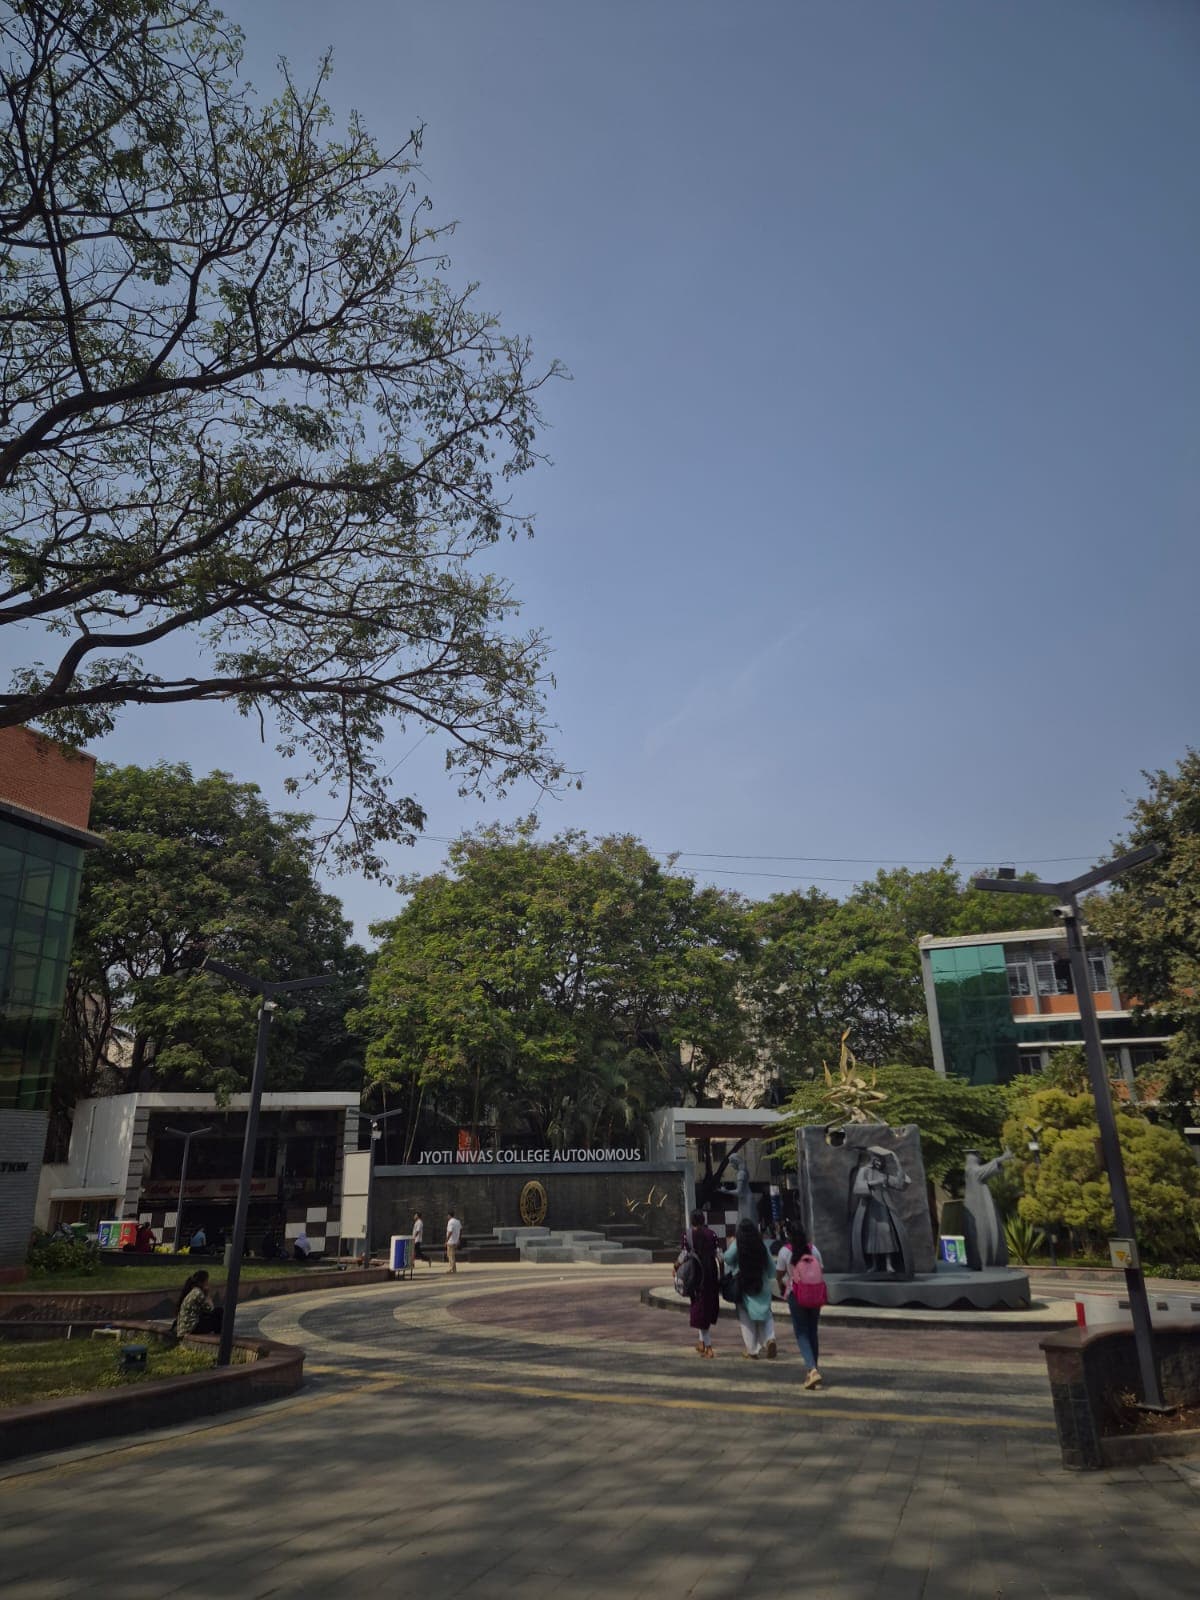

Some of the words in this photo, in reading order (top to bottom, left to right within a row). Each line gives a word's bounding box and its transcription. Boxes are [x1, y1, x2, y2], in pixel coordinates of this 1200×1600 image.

[418, 1151, 453, 1165] JYOTI
[456, 1150, 493, 1164] NIVAS
[496, 1149, 550, 1163] COLLEGE
[552, 1148, 642, 1162] AUTONOMOUS
